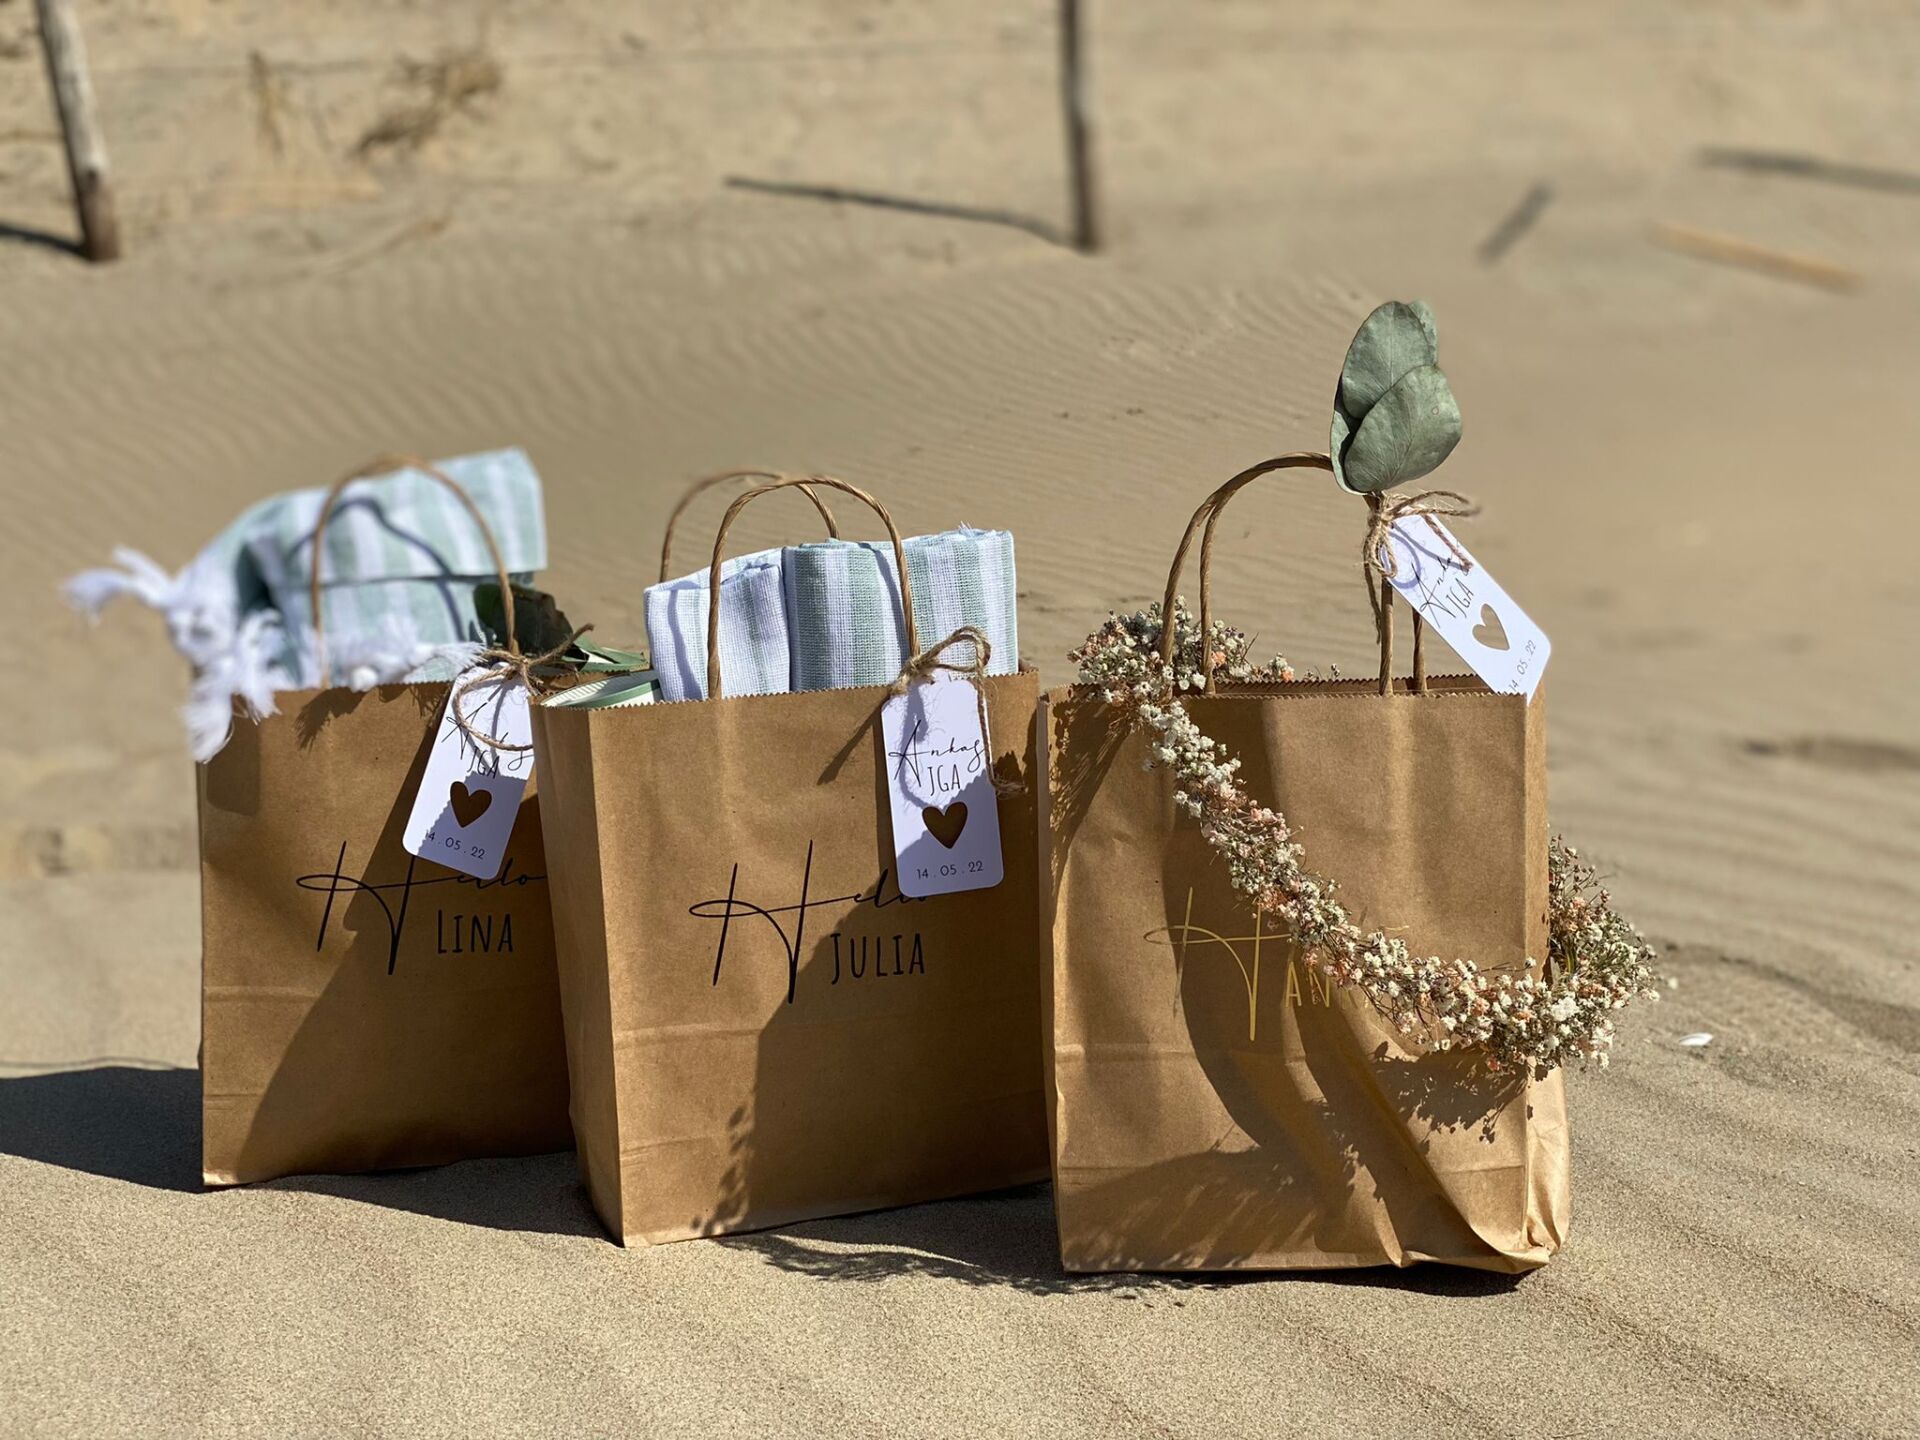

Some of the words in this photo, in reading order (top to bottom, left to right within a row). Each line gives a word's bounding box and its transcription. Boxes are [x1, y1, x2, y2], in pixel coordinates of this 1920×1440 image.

[1446, 577, 1475, 619] JGA
[466, 745, 500, 779] JGA
[927, 763, 961, 796] JGA
[296, 840, 548, 975] Helo
[688, 839, 926, 1003] Hel
[437, 909, 513, 954] LINA
[829, 933, 925, 985] JULIA
